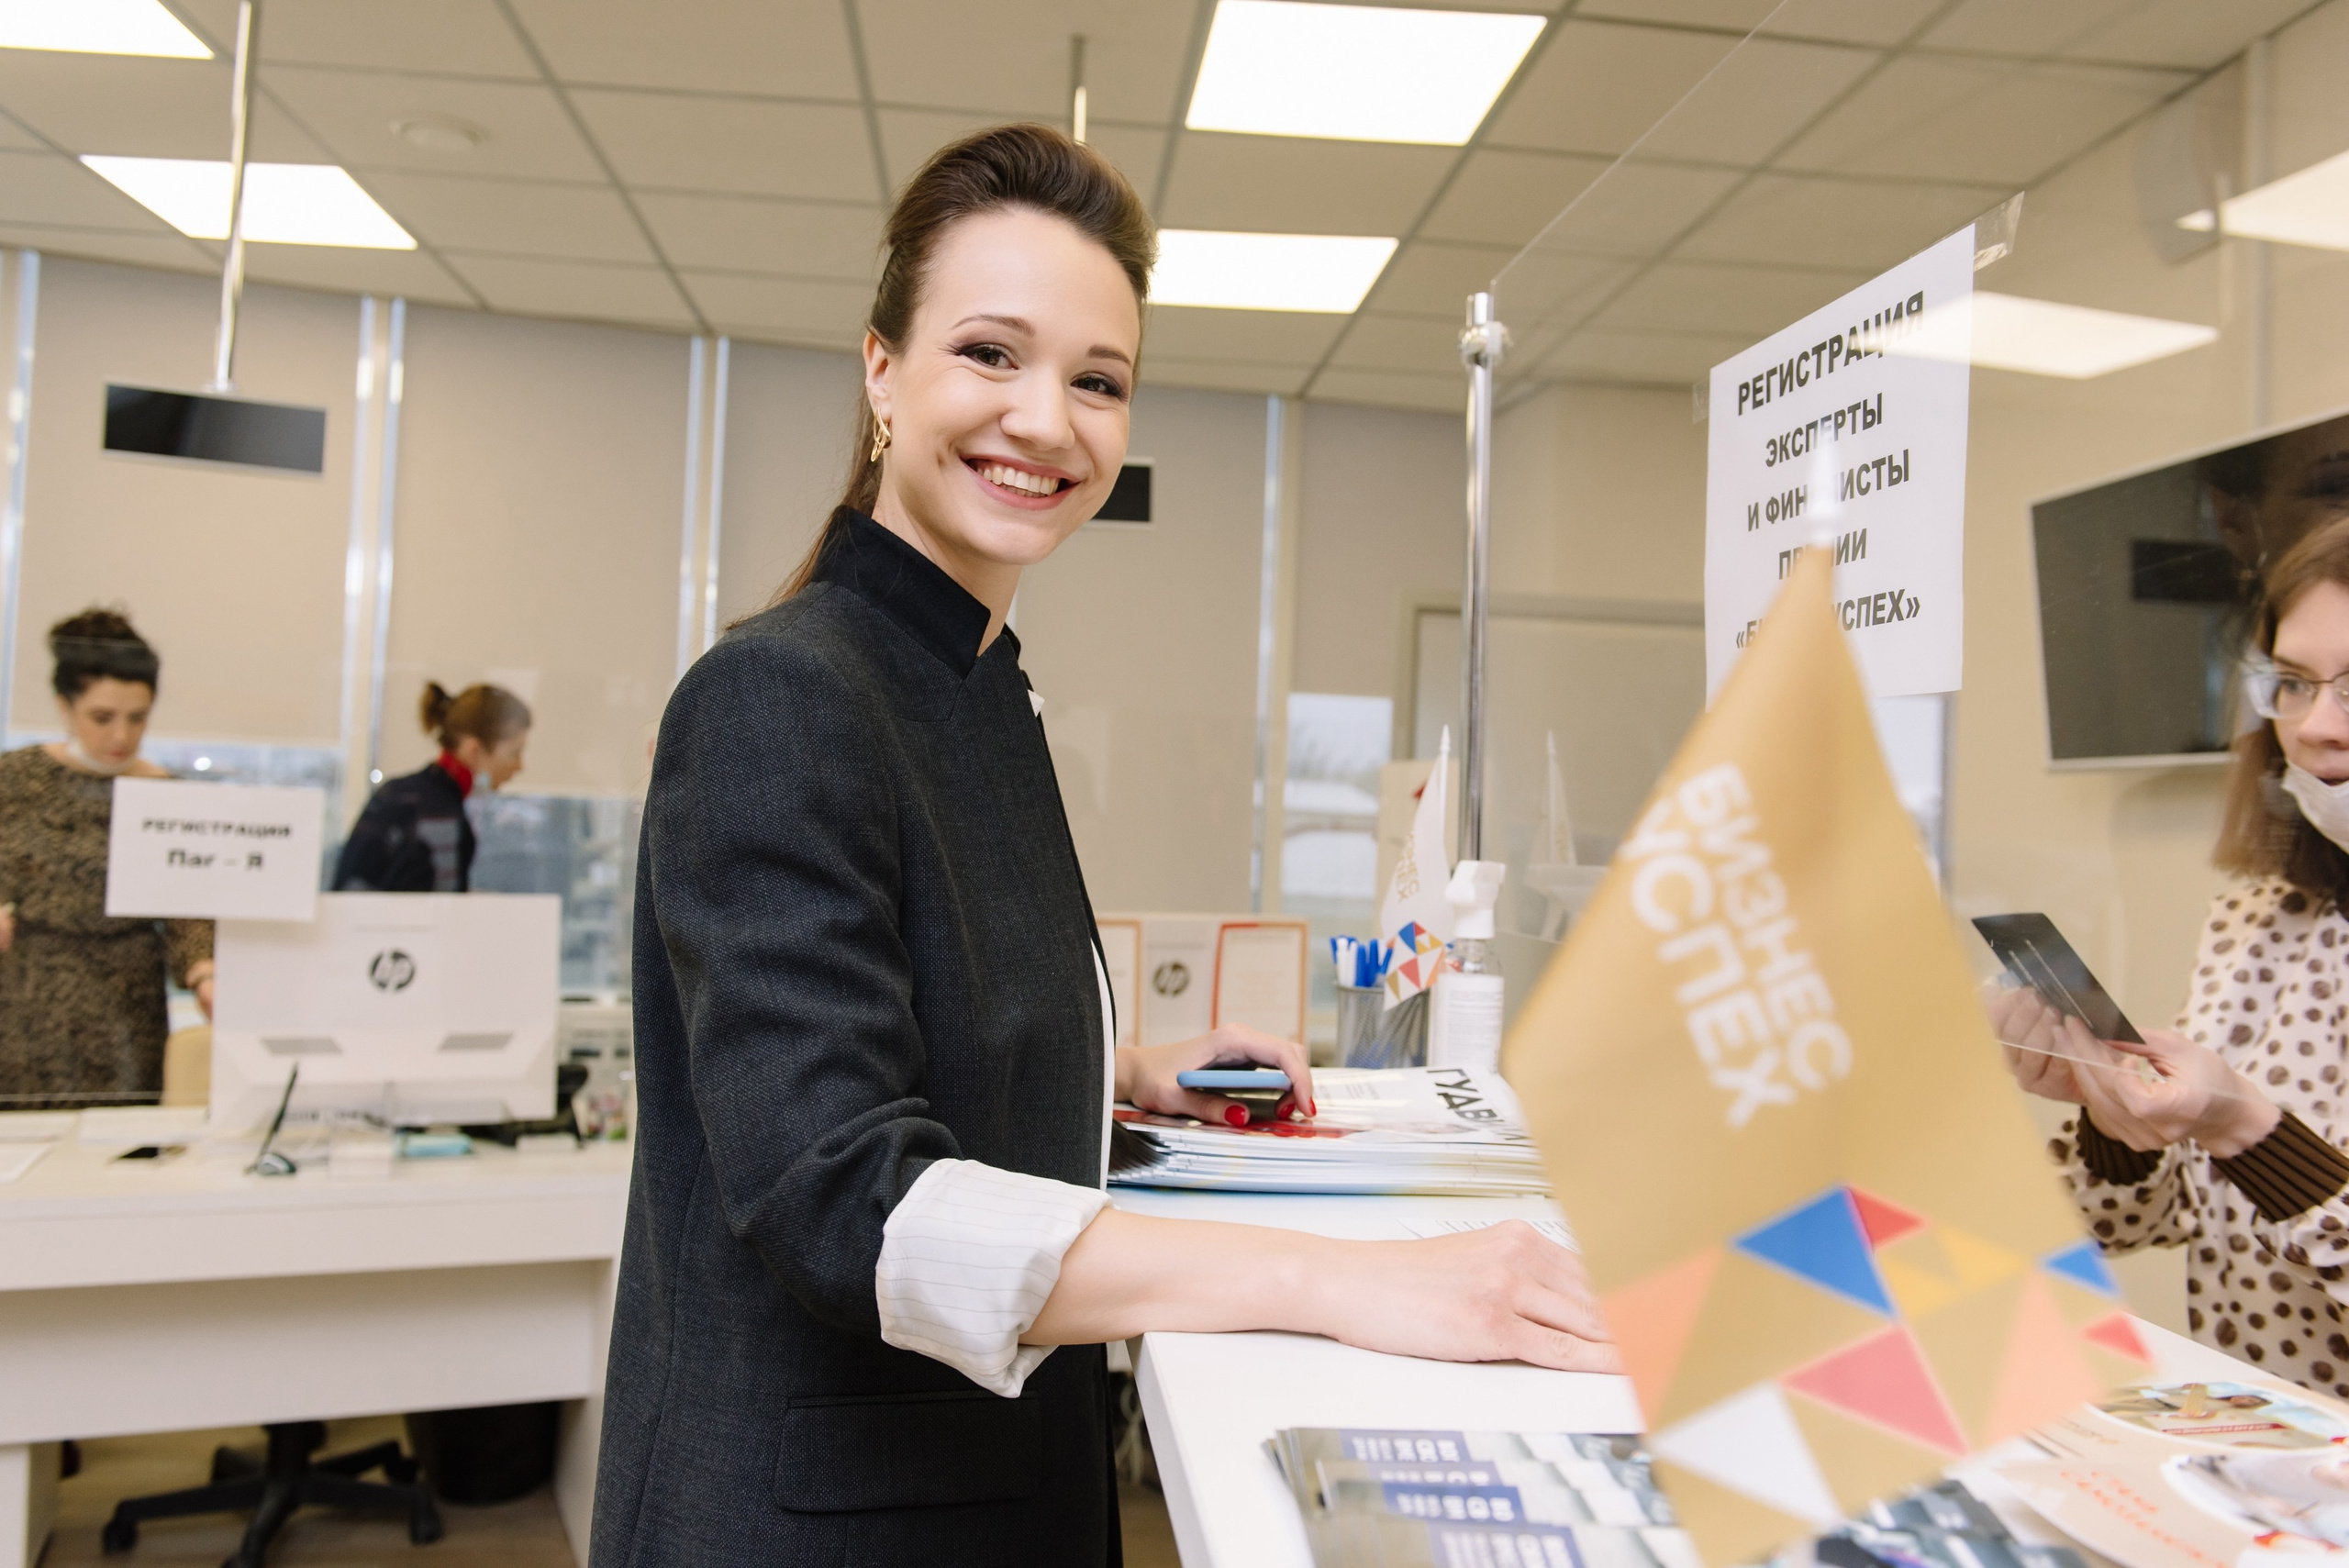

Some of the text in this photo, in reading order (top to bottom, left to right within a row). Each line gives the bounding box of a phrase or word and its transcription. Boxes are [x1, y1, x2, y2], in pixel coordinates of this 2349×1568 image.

[1738, 290, 1923, 417] РЕГИСТРАЦИЯ
[1765, 392, 1883, 468] ЭКСПЕРТЫ
[1747, 448, 1909, 532] И ФИНИСТЫ
[1778, 528, 1867, 580] ПРИИ
[142, 818, 292, 839] РЕГИСТРАЦИЯ
[246, 851, 263, 871] Я
[1620, 796, 1798, 1129] УСПЕХ
[1677, 762, 1854, 1091] БИЗНЕС
